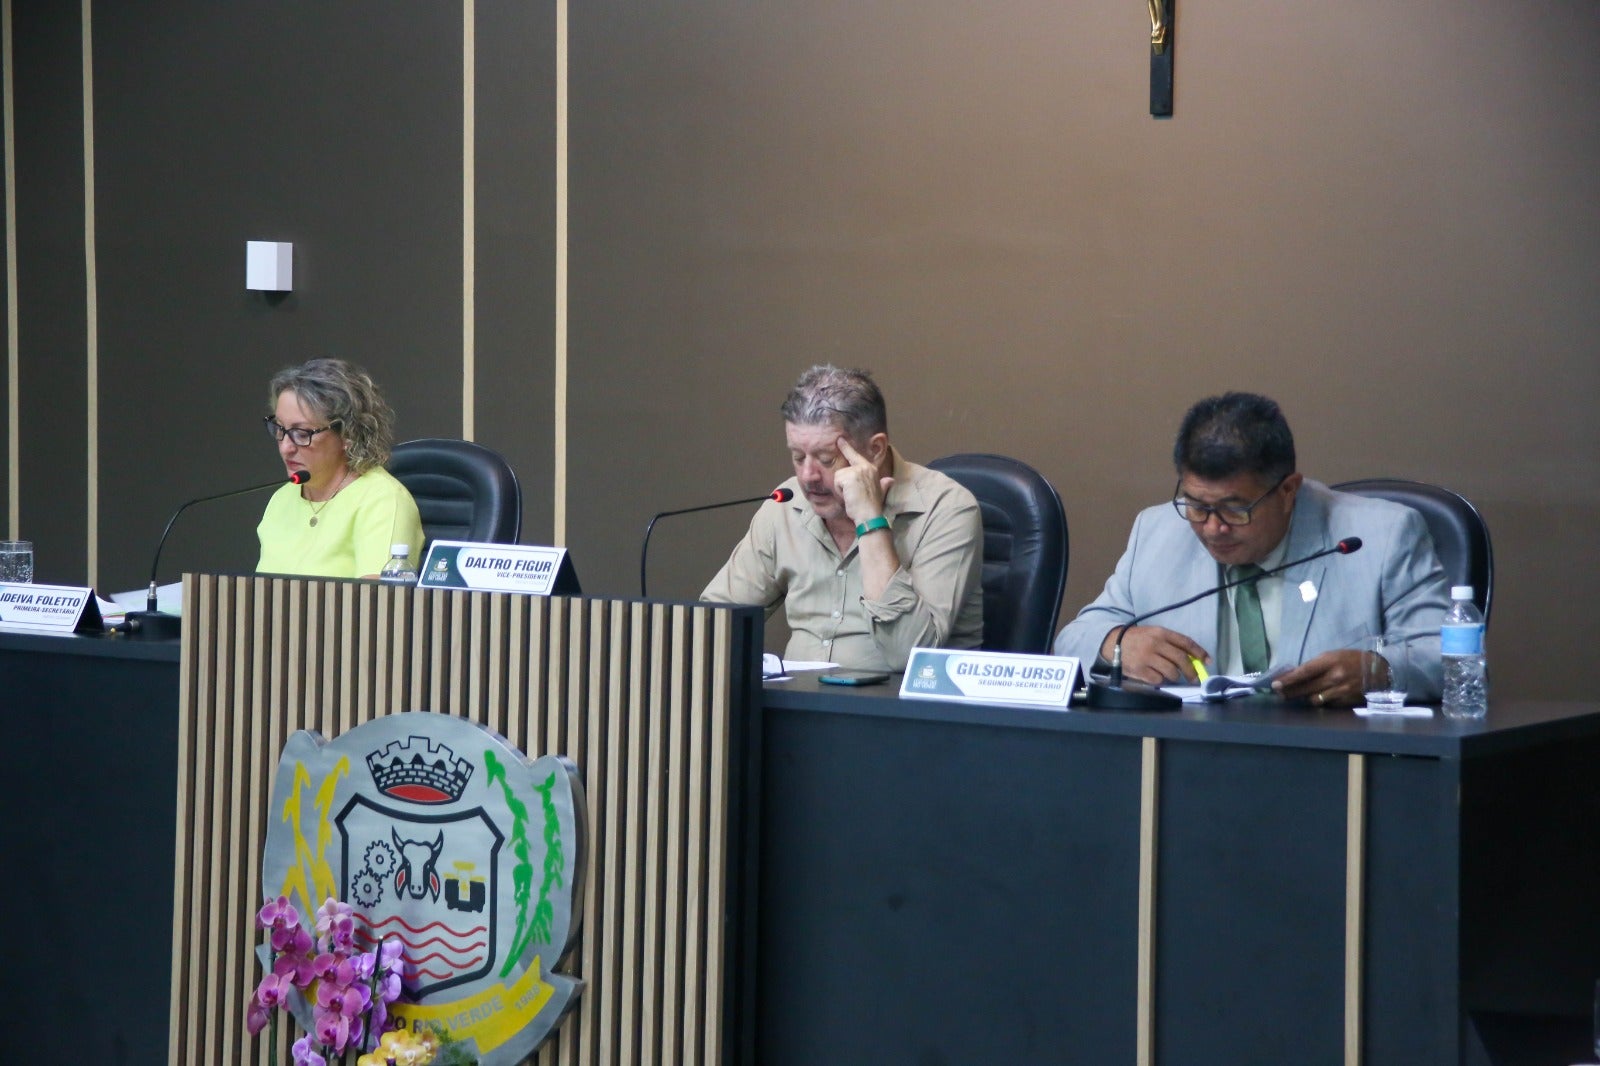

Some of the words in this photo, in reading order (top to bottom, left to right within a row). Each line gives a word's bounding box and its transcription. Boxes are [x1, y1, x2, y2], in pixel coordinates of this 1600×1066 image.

[465, 556, 512, 571] DALTRO
[514, 559, 553, 573] FIGUR
[497, 571, 548, 580] VICE-PRESIDENTE
[0, 592, 33, 604] IDEIVA
[35, 595, 81, 607] FOLETTO
[956, 662, 1066, 682] GILSON-URSO
[446, 994, 504, 1031] VERDE
